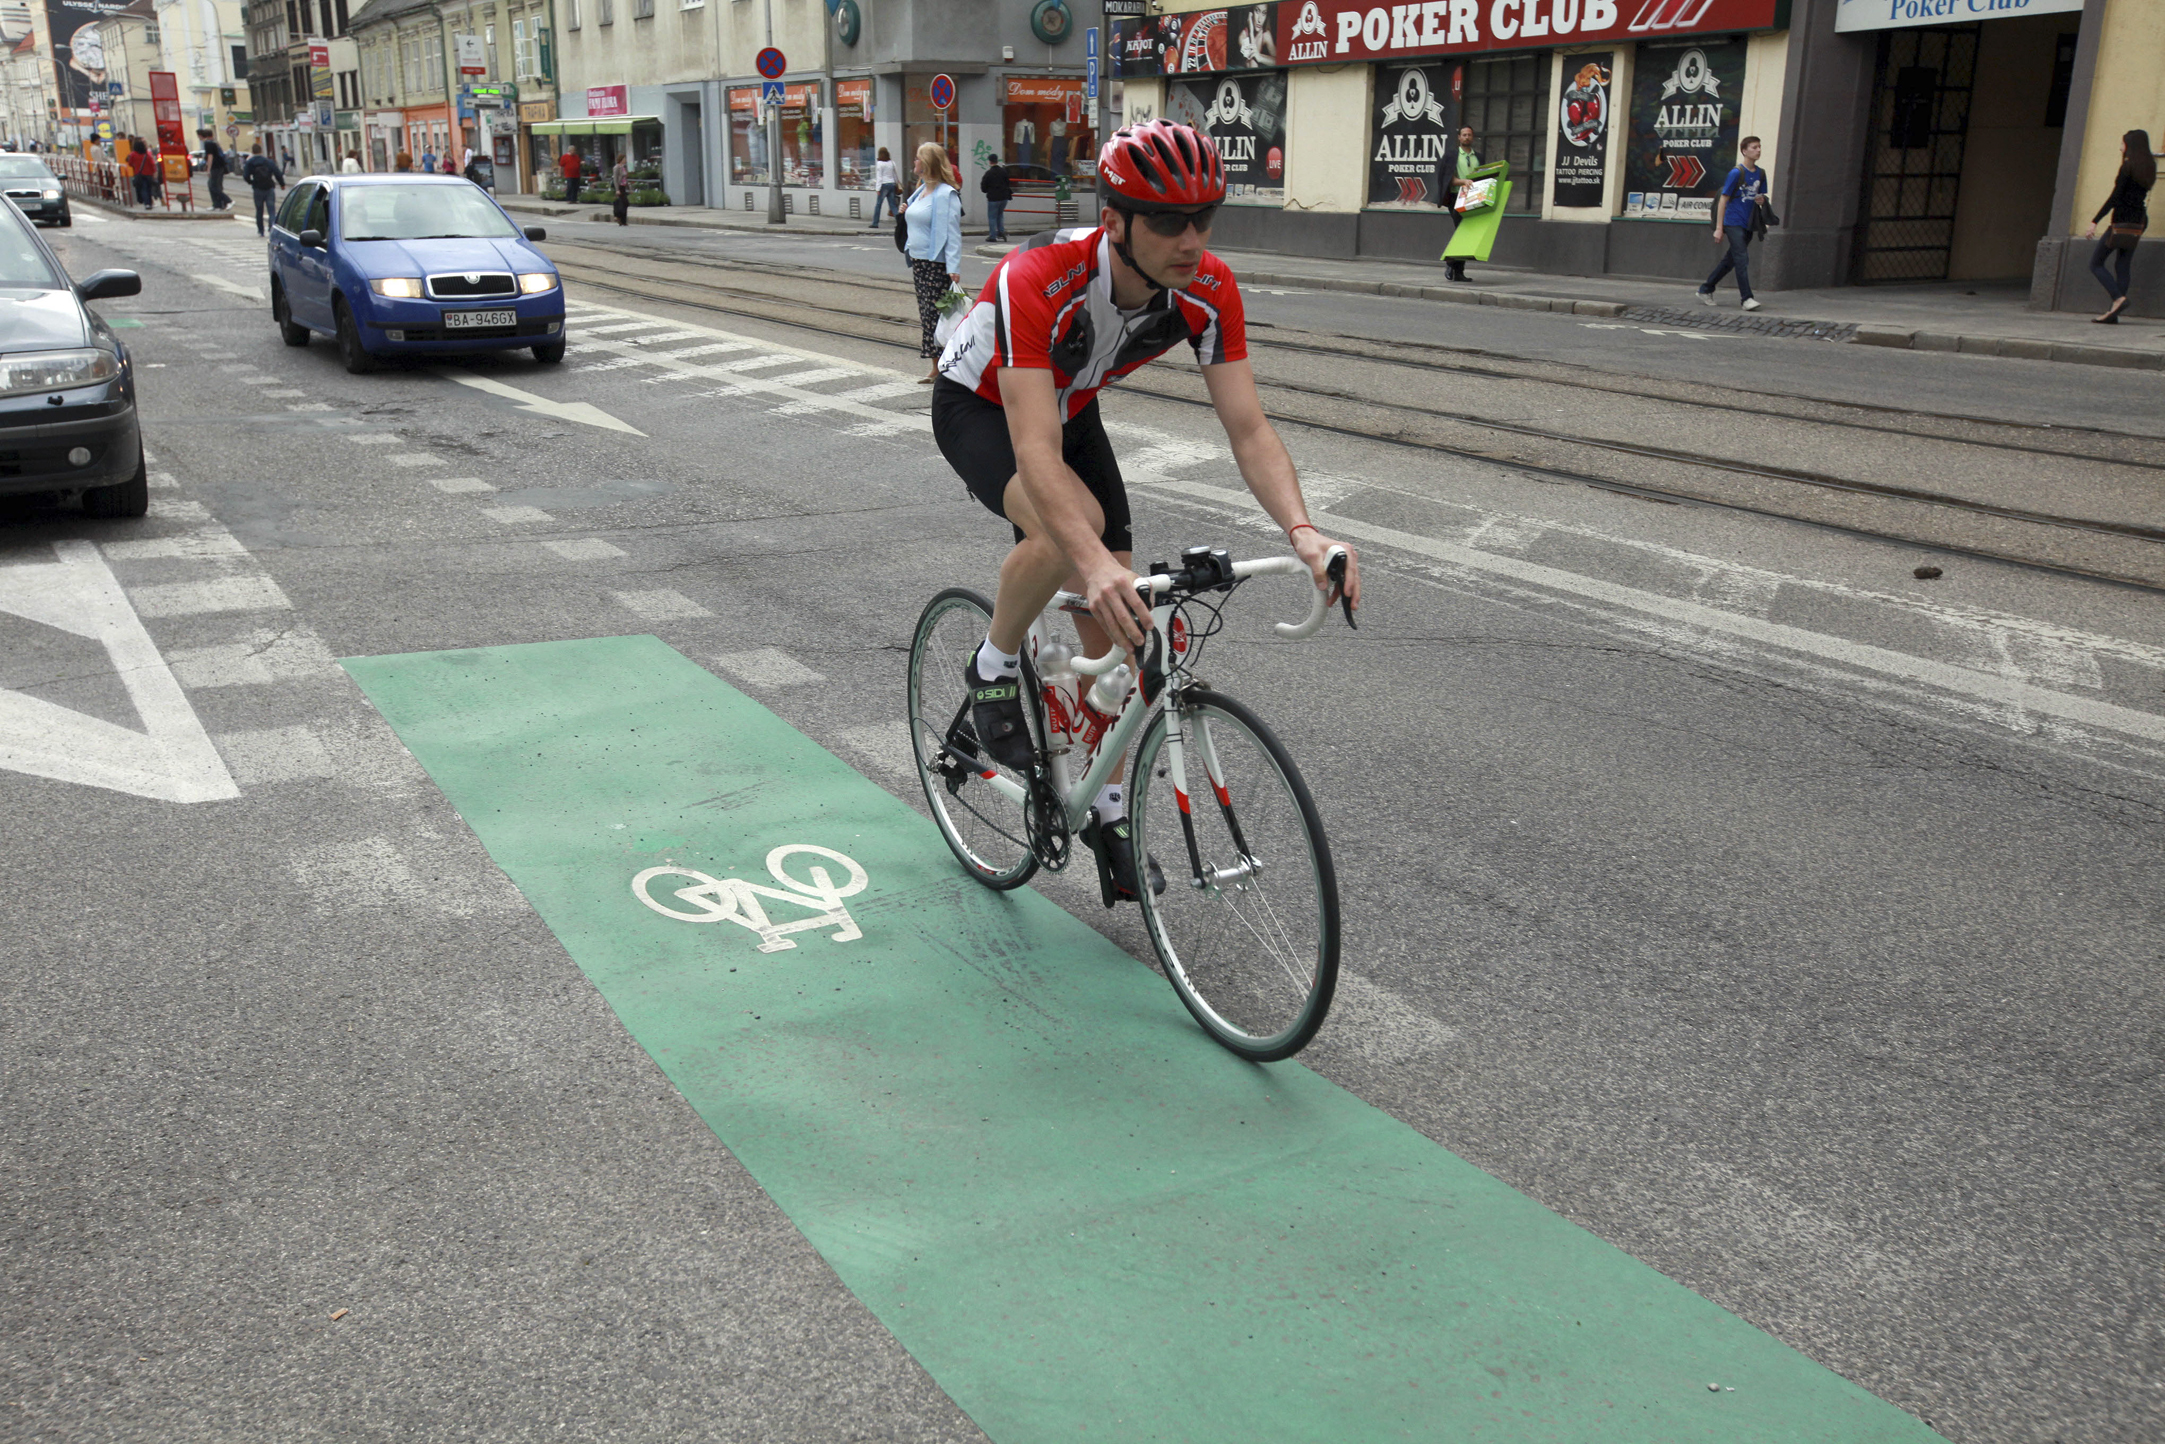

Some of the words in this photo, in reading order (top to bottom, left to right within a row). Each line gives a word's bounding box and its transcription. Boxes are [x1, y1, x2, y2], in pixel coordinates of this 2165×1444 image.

[1889, 0, 1959, 20] Poker
[1336, 0, 1479, 53] POKER
[1490, 0, 1618, 40] CLUB
[1288, 41, 1329, 61] ALLIN
[1008, 82, 1035, 96] Dom
[1654, 104, 1724, 128] ALLIN
[1213, 135, 1257, 161] LLIN
[1375, 134, 1448, 162] ALLIN
[1663, 140, 1690, 148] POKER
[1691, 139, 1713, 148] CLUB
[1231, 164, 1249, 172] CLUB
[1388, 164, 1415, 173] POKER
[1416, 164, 1436, 173] CLUB
[1574, 156, 1598, 166] Devils
[1104, 166, 1126, 185] MET
[1556, 168, 1577, 176] TATTOO
[1578, 168, 1603, 176] PIERCING
[454, 312, 515, 327] BA-946GX
